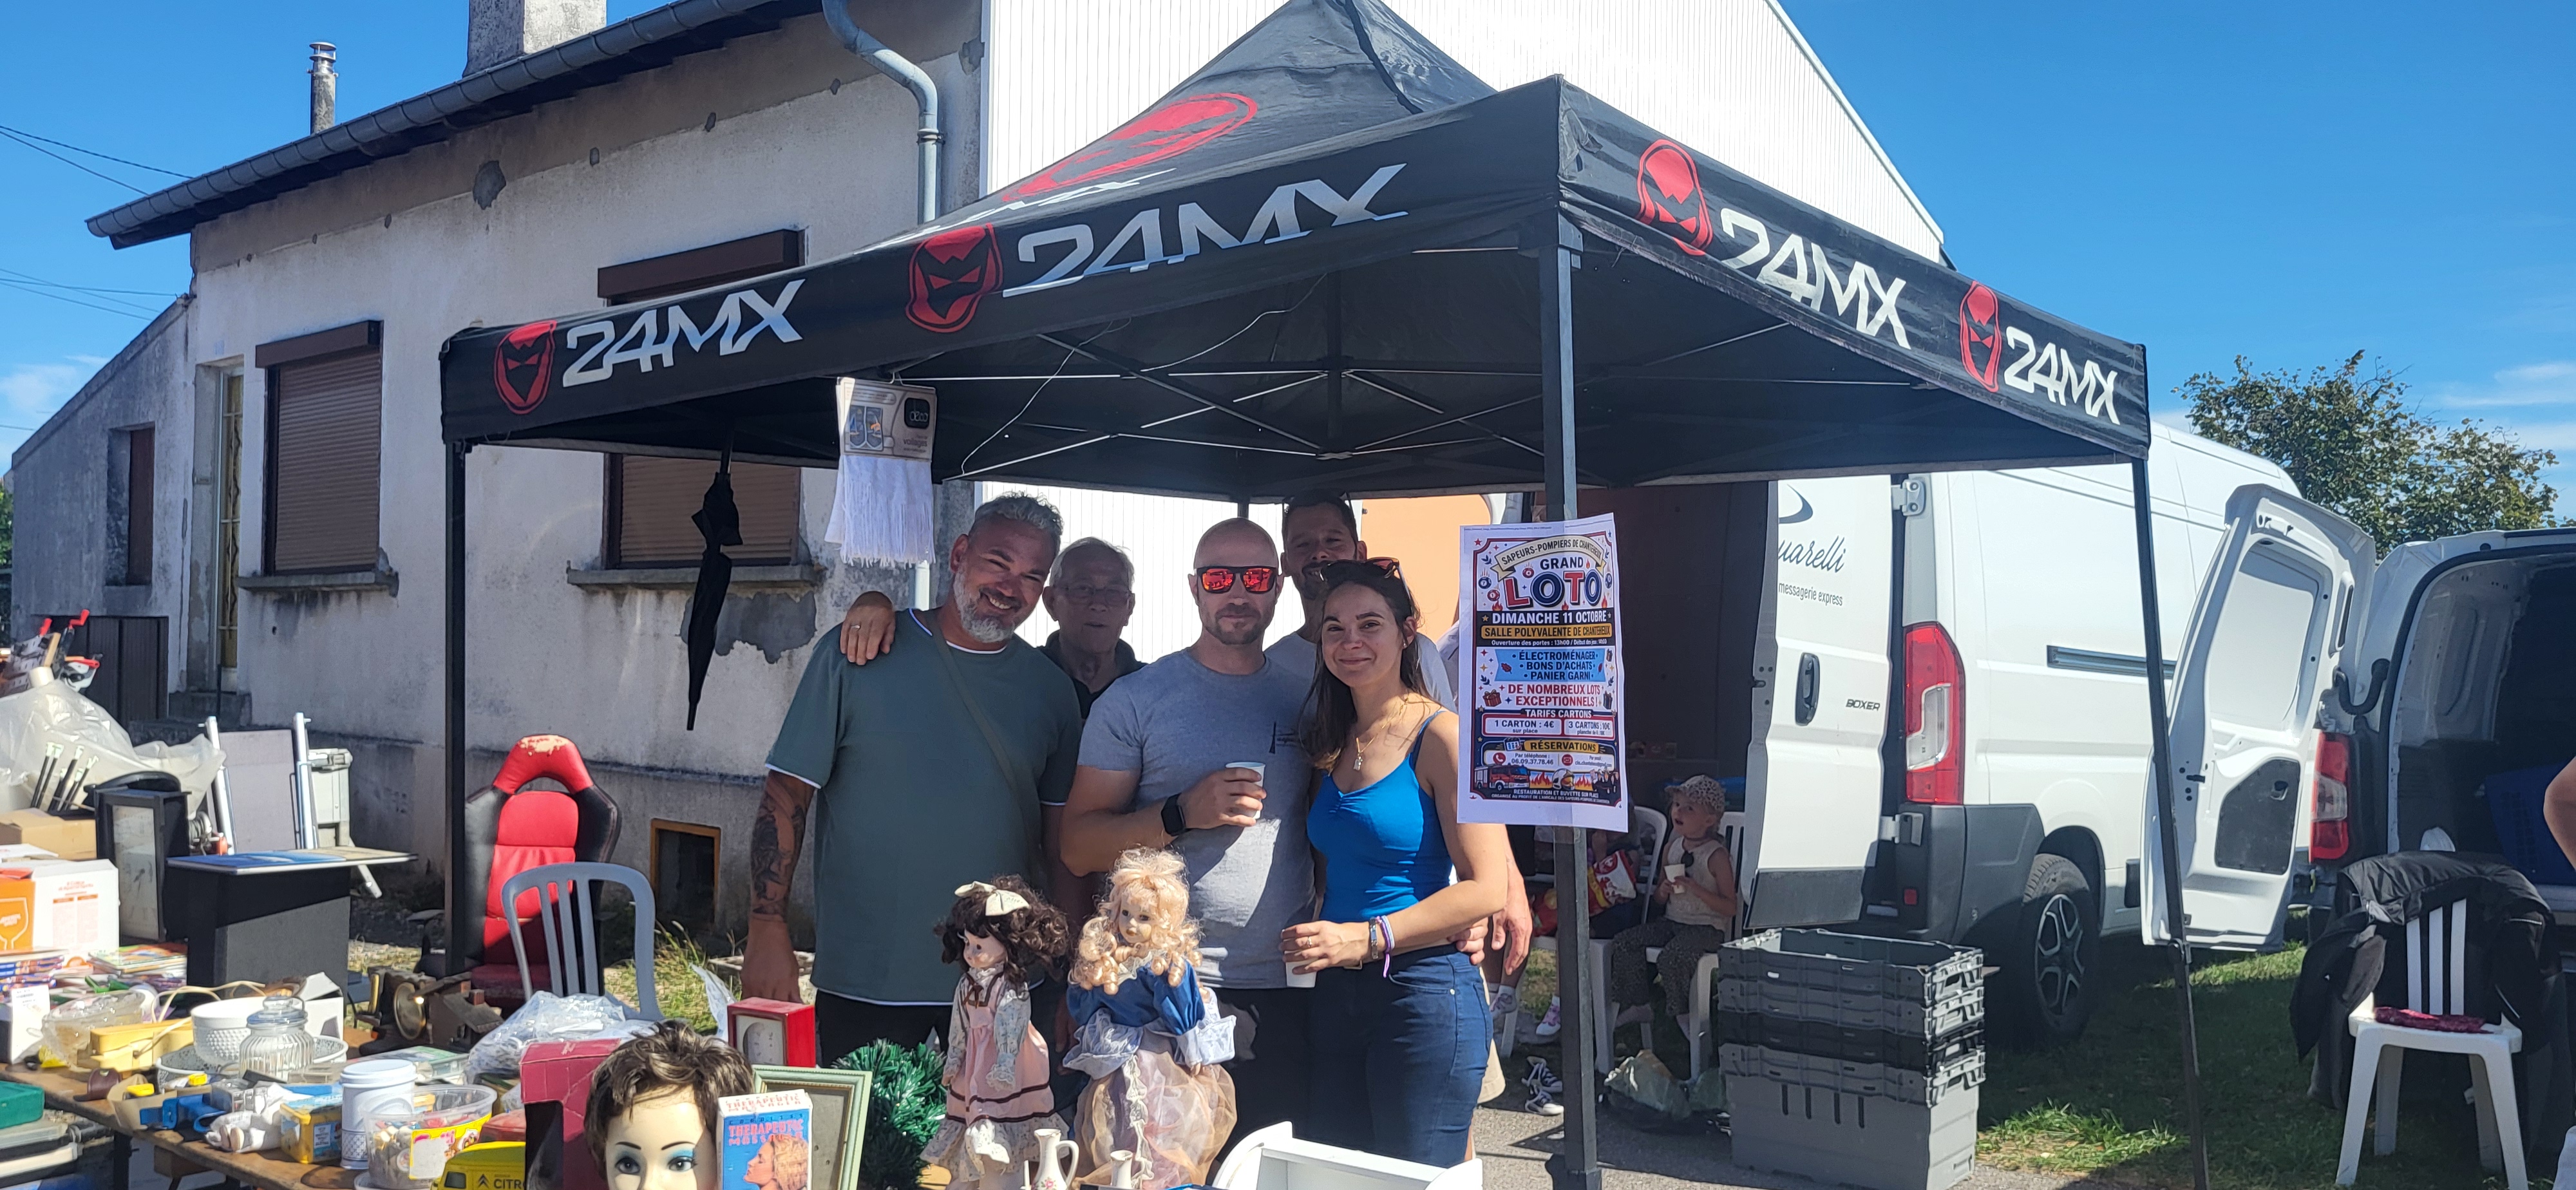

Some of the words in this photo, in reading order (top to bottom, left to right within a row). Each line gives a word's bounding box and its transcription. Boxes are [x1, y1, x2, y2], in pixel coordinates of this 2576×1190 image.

[1003, 162, 1408, 298] 24MX
[1719, 207, 1911, 350] 24MX
[562, 279, 806, 387] 24MX
[2005, 326, 2121, 426] 24MX
[1501, 539, 1571, 565] SAPEURS-POMPIERS
[1573, 540, 1578, 548] DE
[1540, 556, 1584, 570] GRAND
[1503, 569, 1602, 609] LOTO
[1778, 582, 1817, 601] messagerie
[1818, 590, 1843, 607] express
[1492, 612, 1560, 624] DIMANCHE
[1562, 612, 1573, 623] 11
[1575, 610, 1607, 623] OCTOBRE
[1484, 627, 1512, 637] SALLE
[1514, 627, 1571, 638] POLYVALENTE
[1573, 627, 1581, 636] DE
[1519, 649, 1596, 661] ÉLECTROMÉNAGER
[1526, 661, 1553, 670] BONS
[1556, 661, 1593, 670] D'ACHATS
[1530, 671, 1565, 680] PANIER
[1567, 671, 1591, 680] GARNI
[1508, 684, 1524, 694] DE
[1527, 684, 1586, 695] NOMBREUX
[1587, 685, 1600, 695] LOTS
[1846, 698, 1880, 712] BOXER
[1524, 709, 1556, 717] TARIFS
[1558, 710, 1592, 719] CARTONS
[1568, 721, 1573, 729] 3
[1575, 721, 1599, 730] CARTONS
[1530, 740, 1596, 752] RÉSERVATIONS
[728, 1118, 804, 1138] THERAPEUTIC
[493, 1178, 525, 1190] CITR
